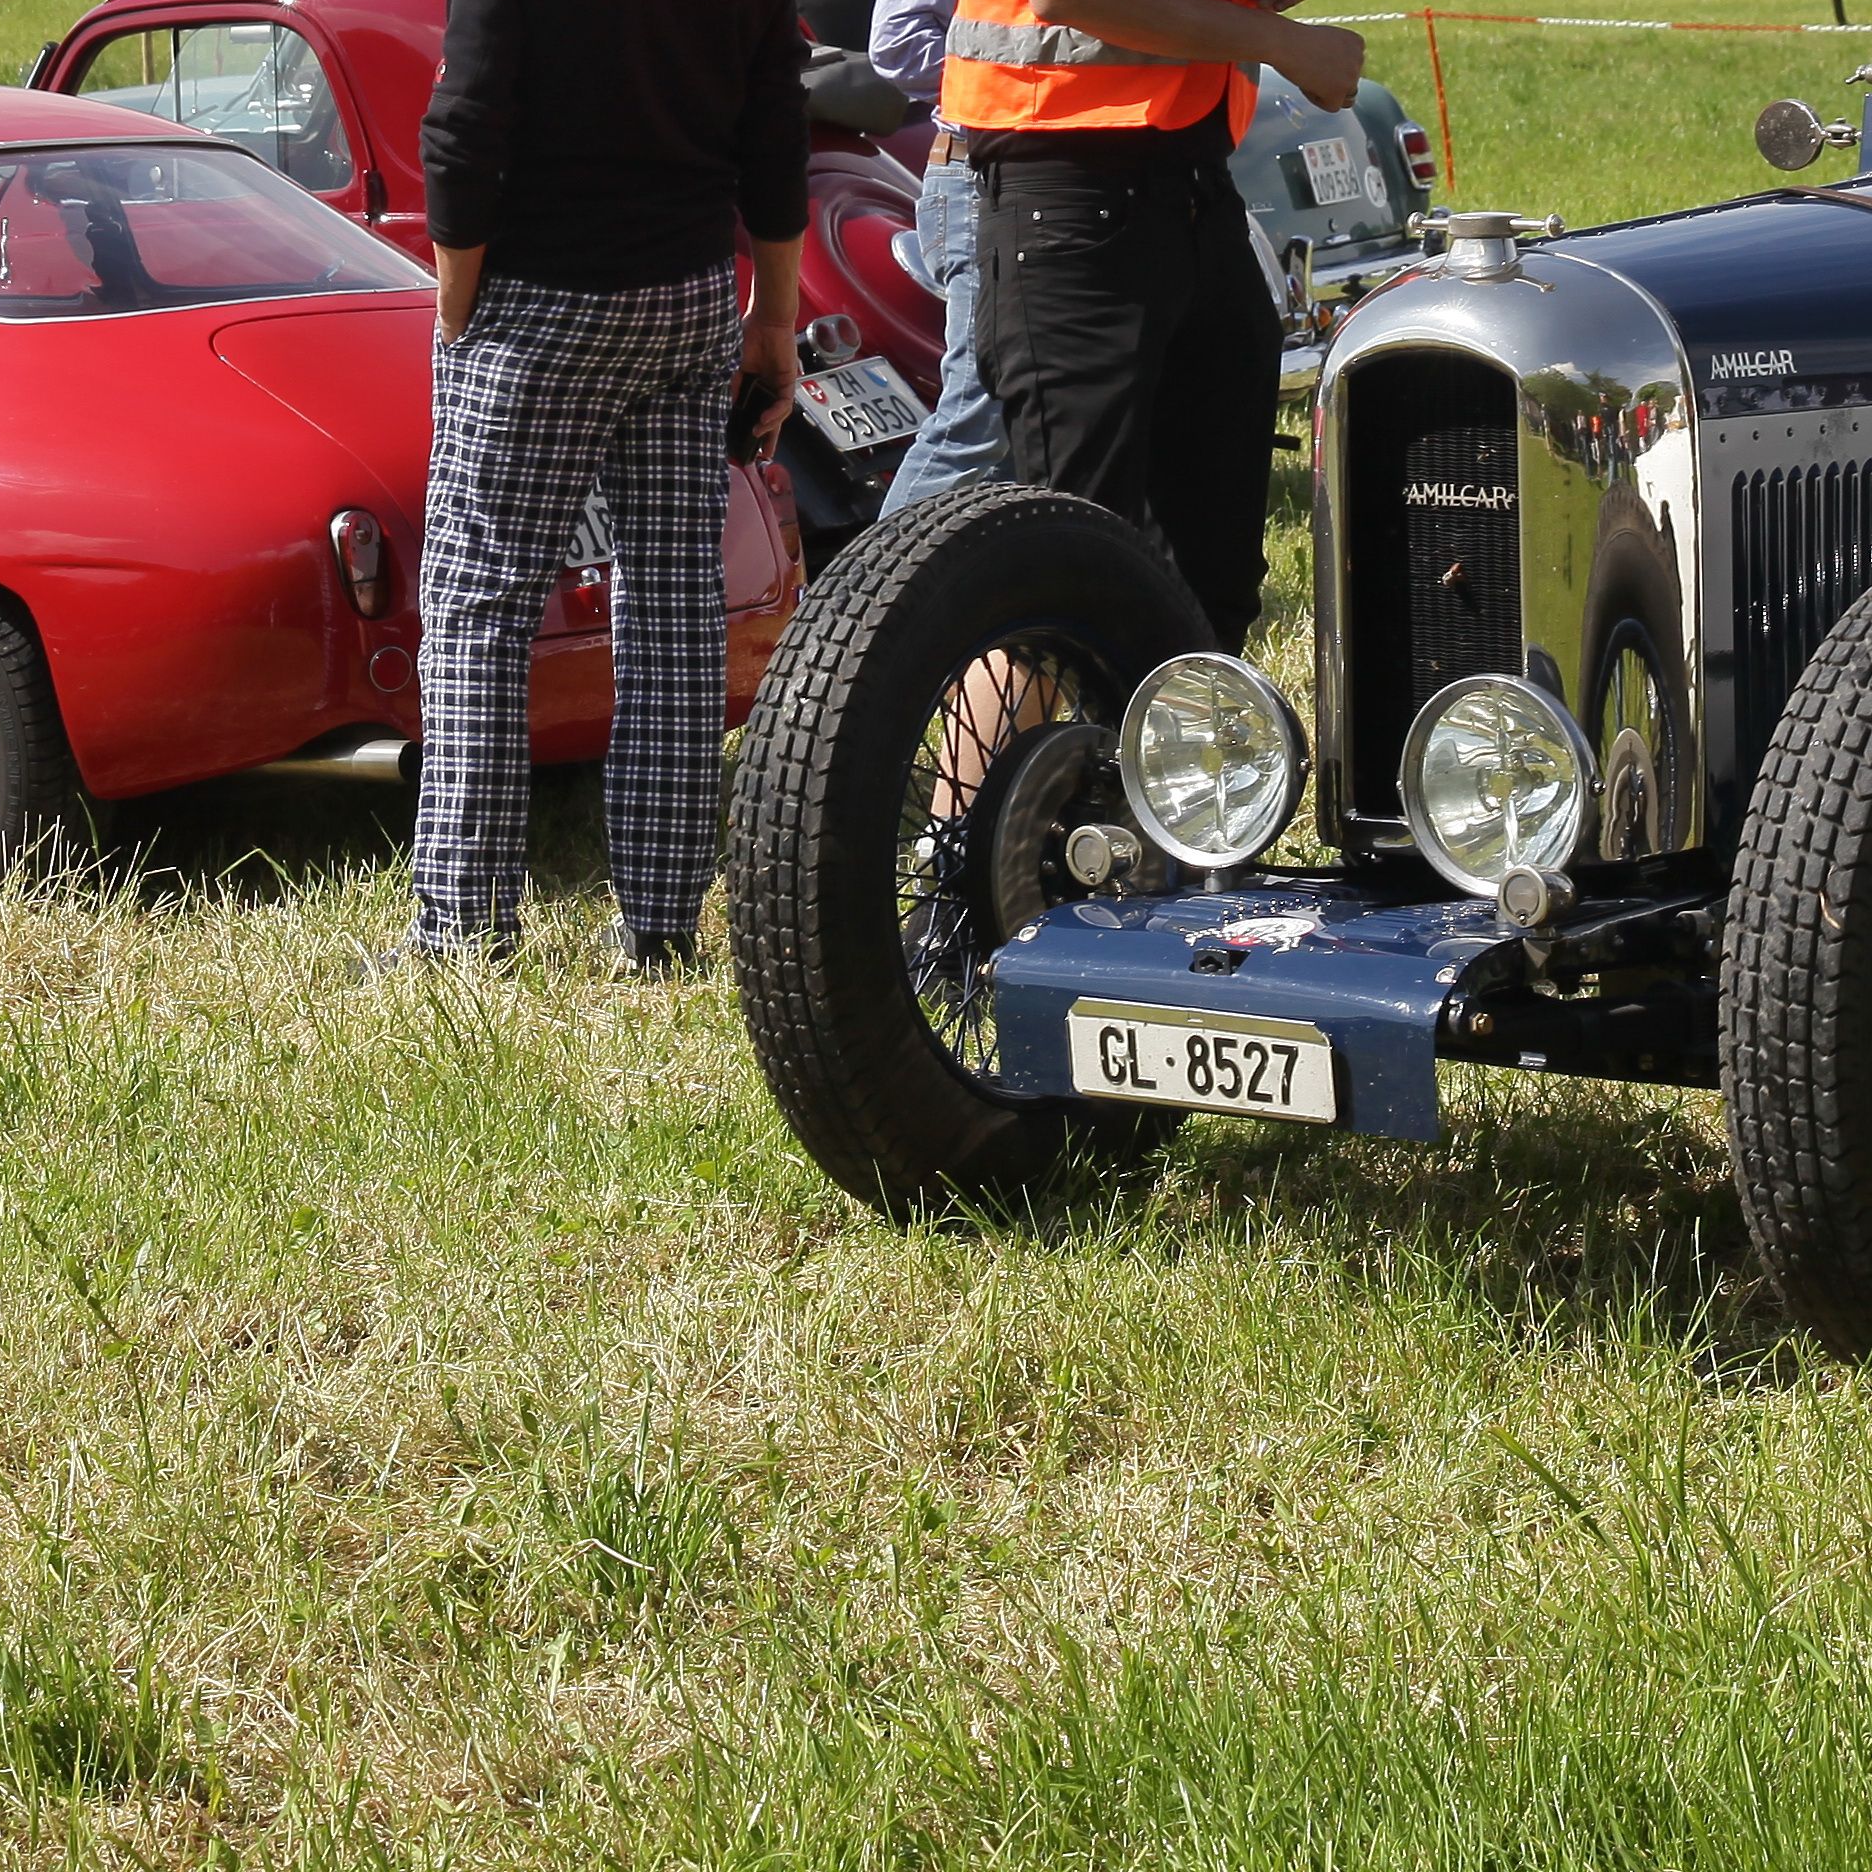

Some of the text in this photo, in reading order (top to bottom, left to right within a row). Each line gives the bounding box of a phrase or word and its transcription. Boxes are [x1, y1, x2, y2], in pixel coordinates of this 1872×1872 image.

[1319, 145, 1335, 167] BE
[1367, 171, 1386, 205] CH
[1711, 350, 1797, 380] AMILCAR
[828, 370, 867, 398] ZH
[1406, 482, 1510, 510] AMILCAR
[1186, 1034, 1298, 1105] 8527
